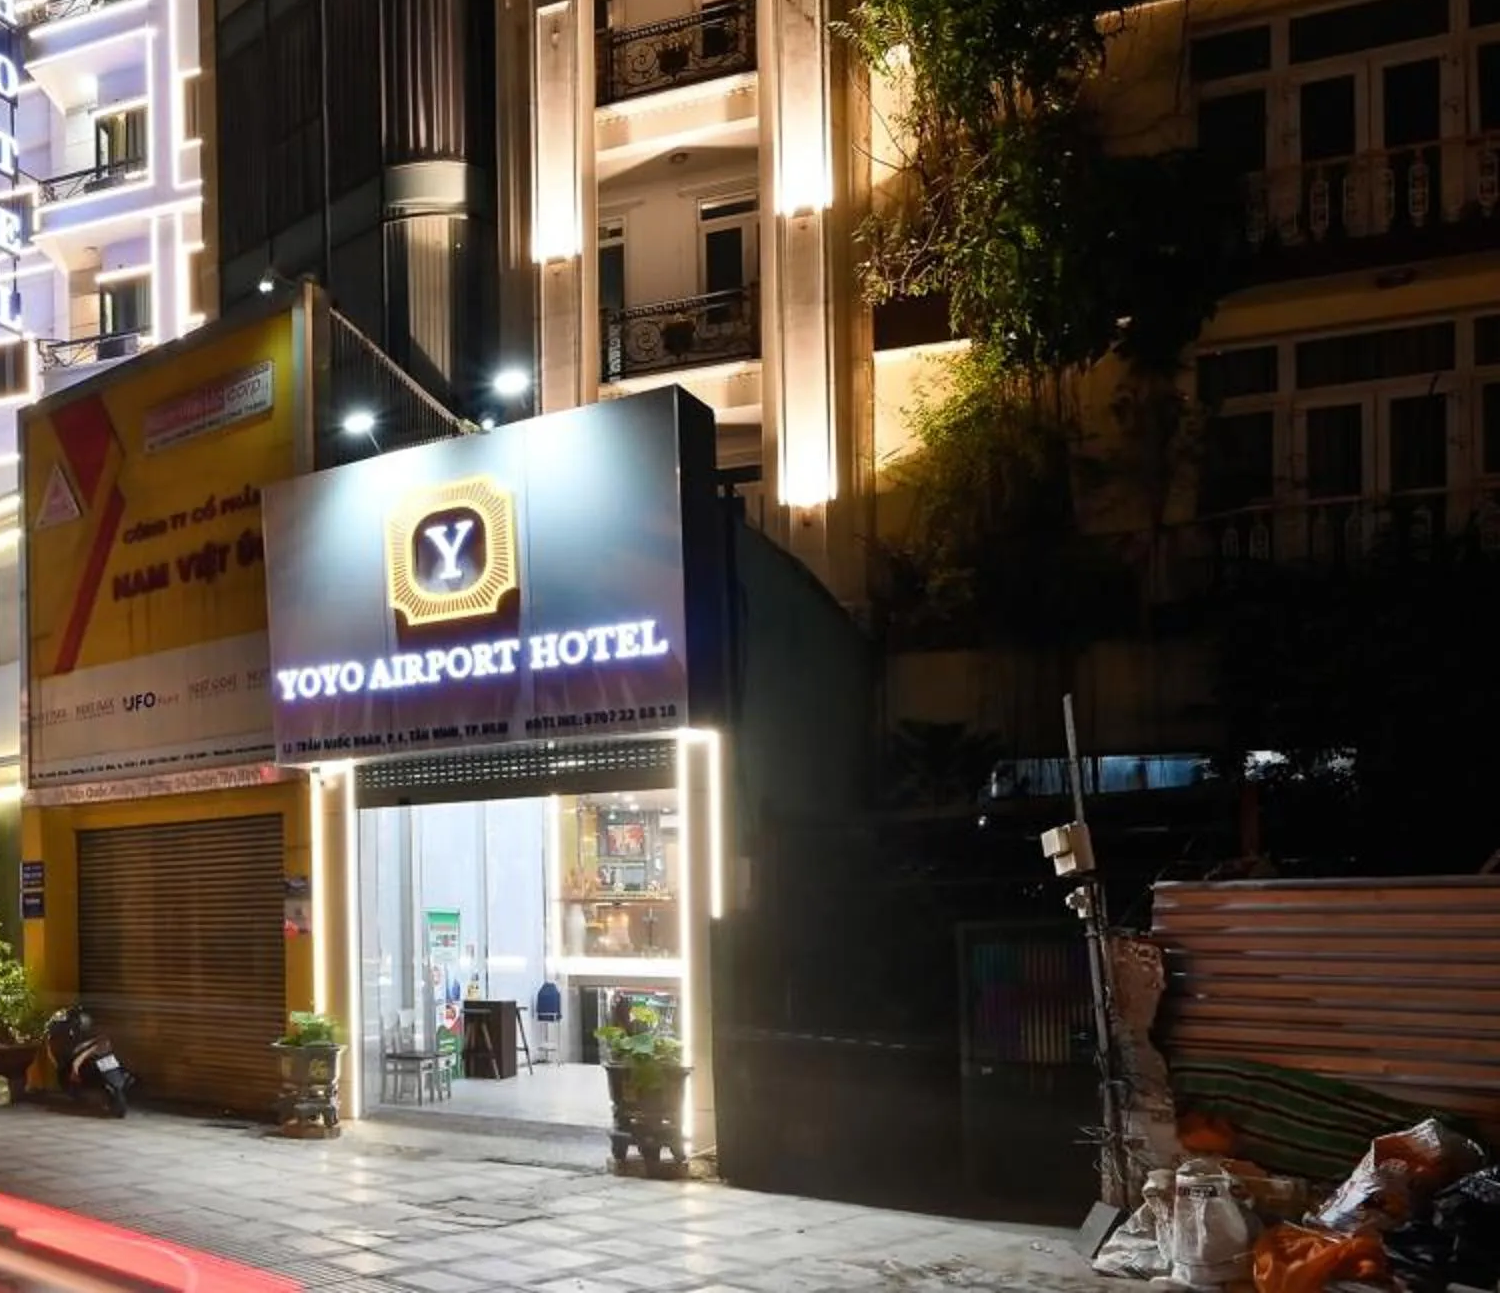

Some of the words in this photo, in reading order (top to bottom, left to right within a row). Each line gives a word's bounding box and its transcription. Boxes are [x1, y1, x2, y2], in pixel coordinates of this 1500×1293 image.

[424, 519, 474, 580] Y
[113, 562, 169, 602] NAM
[276, 661, 364, 701] YOYO
[368, 638, 520, 691] AIRPORT
[529, 619, 669, 670] HOTEL
[122, 691, 157, 713] UFO
